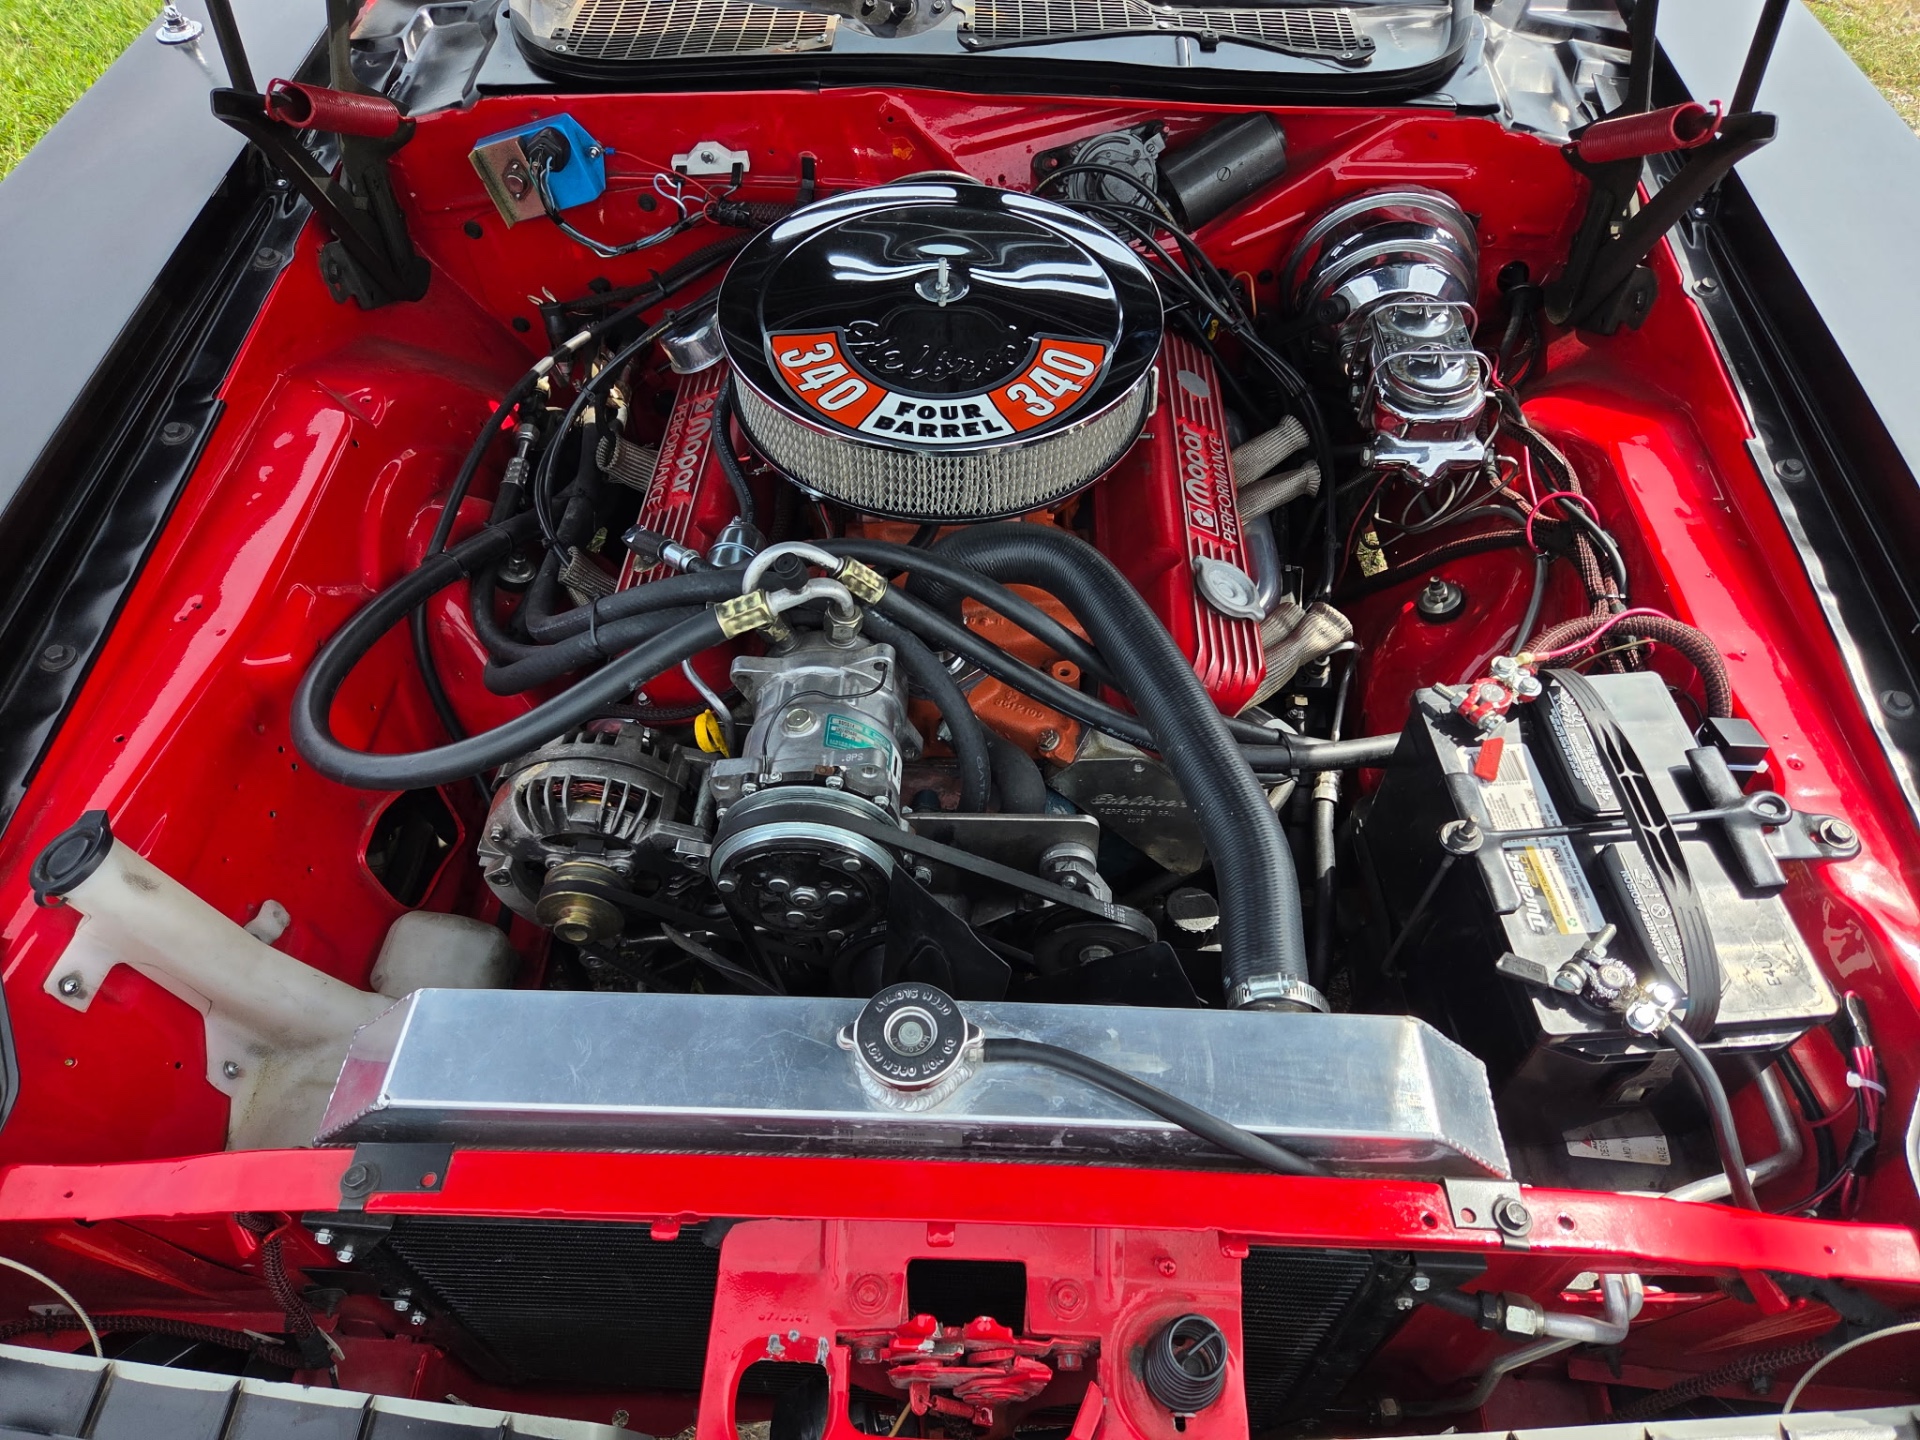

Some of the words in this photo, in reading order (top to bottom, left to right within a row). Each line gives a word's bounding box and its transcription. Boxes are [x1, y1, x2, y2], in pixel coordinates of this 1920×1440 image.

[780, 342, 868, 412] 340
[1006, 348, 1096, 417] 340
[895, 401, 984, 420] FOUR
[873, 415, 1003, 438] BARREL
[647, 403, 689, 512] PERFORMANCE
[1209, 434, 1236, 544] PERFORMANCE
[1099, 807, 1152, 816] PERFORMER
[1550, 847, 1563, 865] 700
[1520, 855, 1538, 889] GOLD
[1505, 852, 1548, 932] Duralast
[1547, 889, 1560, 917] PROVEN
[875, 989, 919, 1013] SLOWLY
[922, 991, 952, 1015] OPEN
[865, 1041, 884, 1062] HOT
[942, 1037, 957, 1055] DO
[883, 1059, 917, 1077] OPEN
[922, 1056, 945, 1075] NOT
